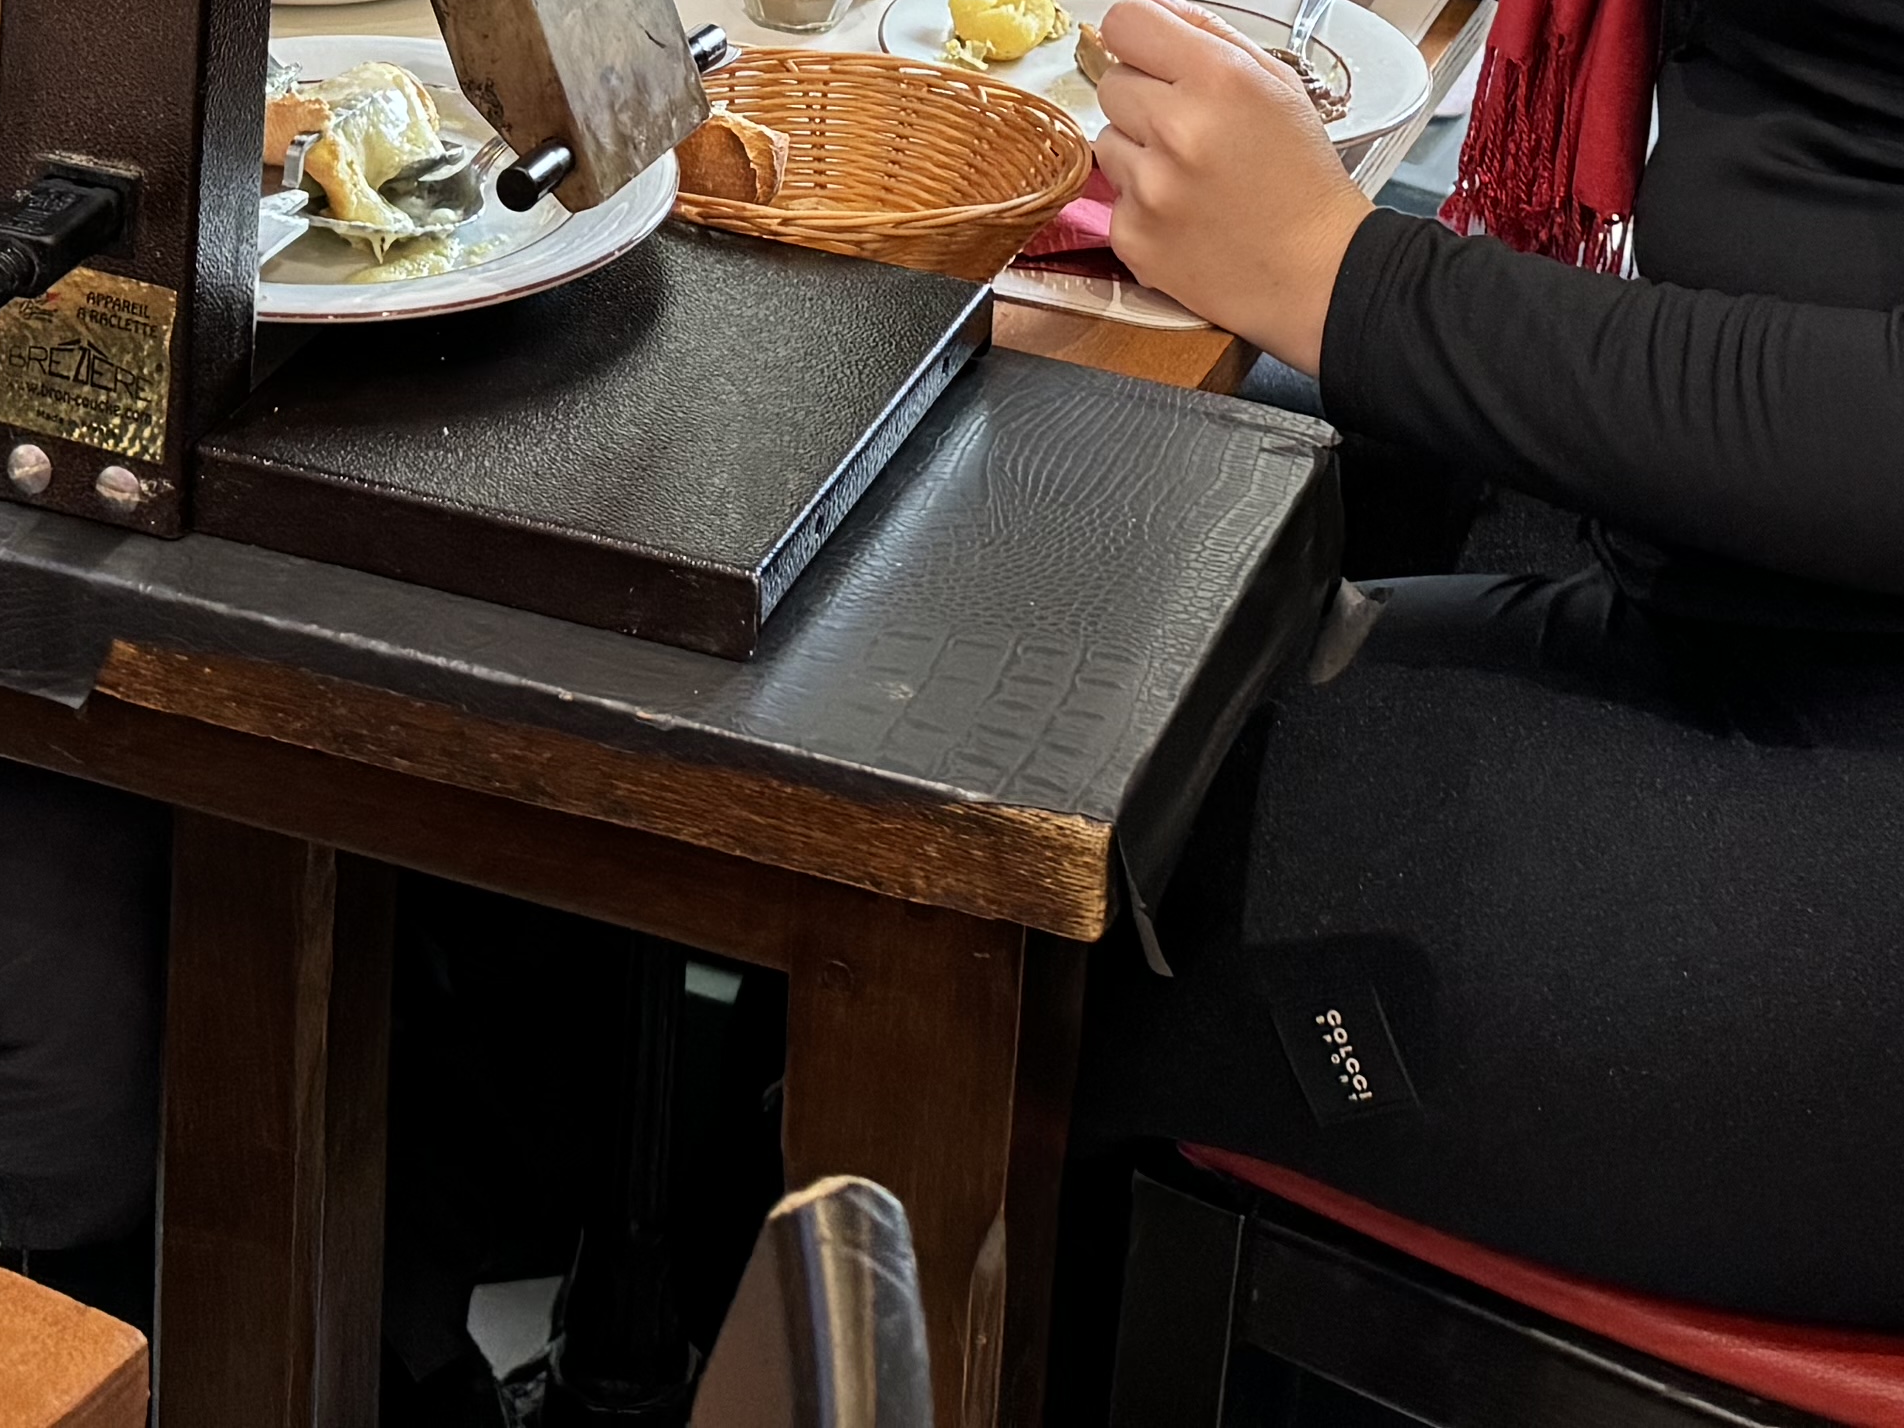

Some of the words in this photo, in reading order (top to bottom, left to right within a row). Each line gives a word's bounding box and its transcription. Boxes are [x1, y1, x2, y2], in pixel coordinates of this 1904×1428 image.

[86, 291, 151, 319] APPAREIL
[89, 309, 158, 338] RACLETTE
[1327, 1009, 1373, 1101] COLCCI
